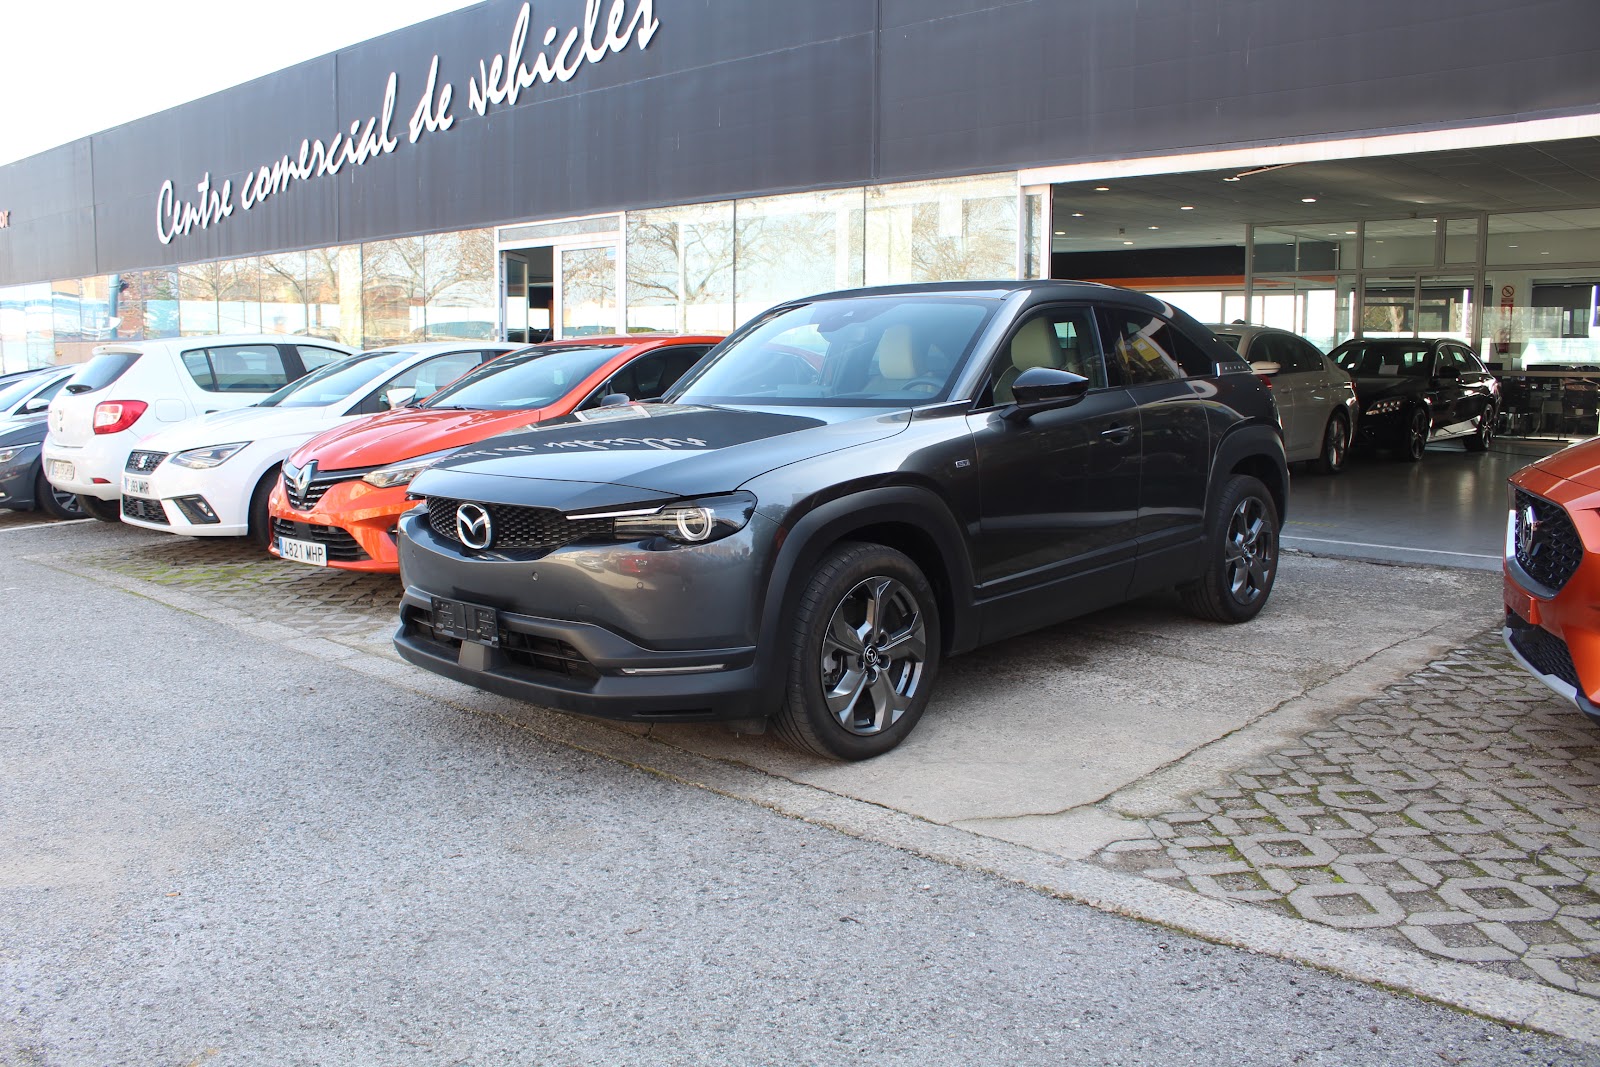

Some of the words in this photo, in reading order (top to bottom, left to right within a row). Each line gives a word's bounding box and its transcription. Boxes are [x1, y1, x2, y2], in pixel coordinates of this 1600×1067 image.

[156, 171, 234, 245] Centre
[240, 71, 398, 210] comercial
[408, 54, 454, 144] de
[468, 0, 660, 116] vehicles
[284, 541, 303, 560] 4821
[305, 544, 324, 562] MHP
